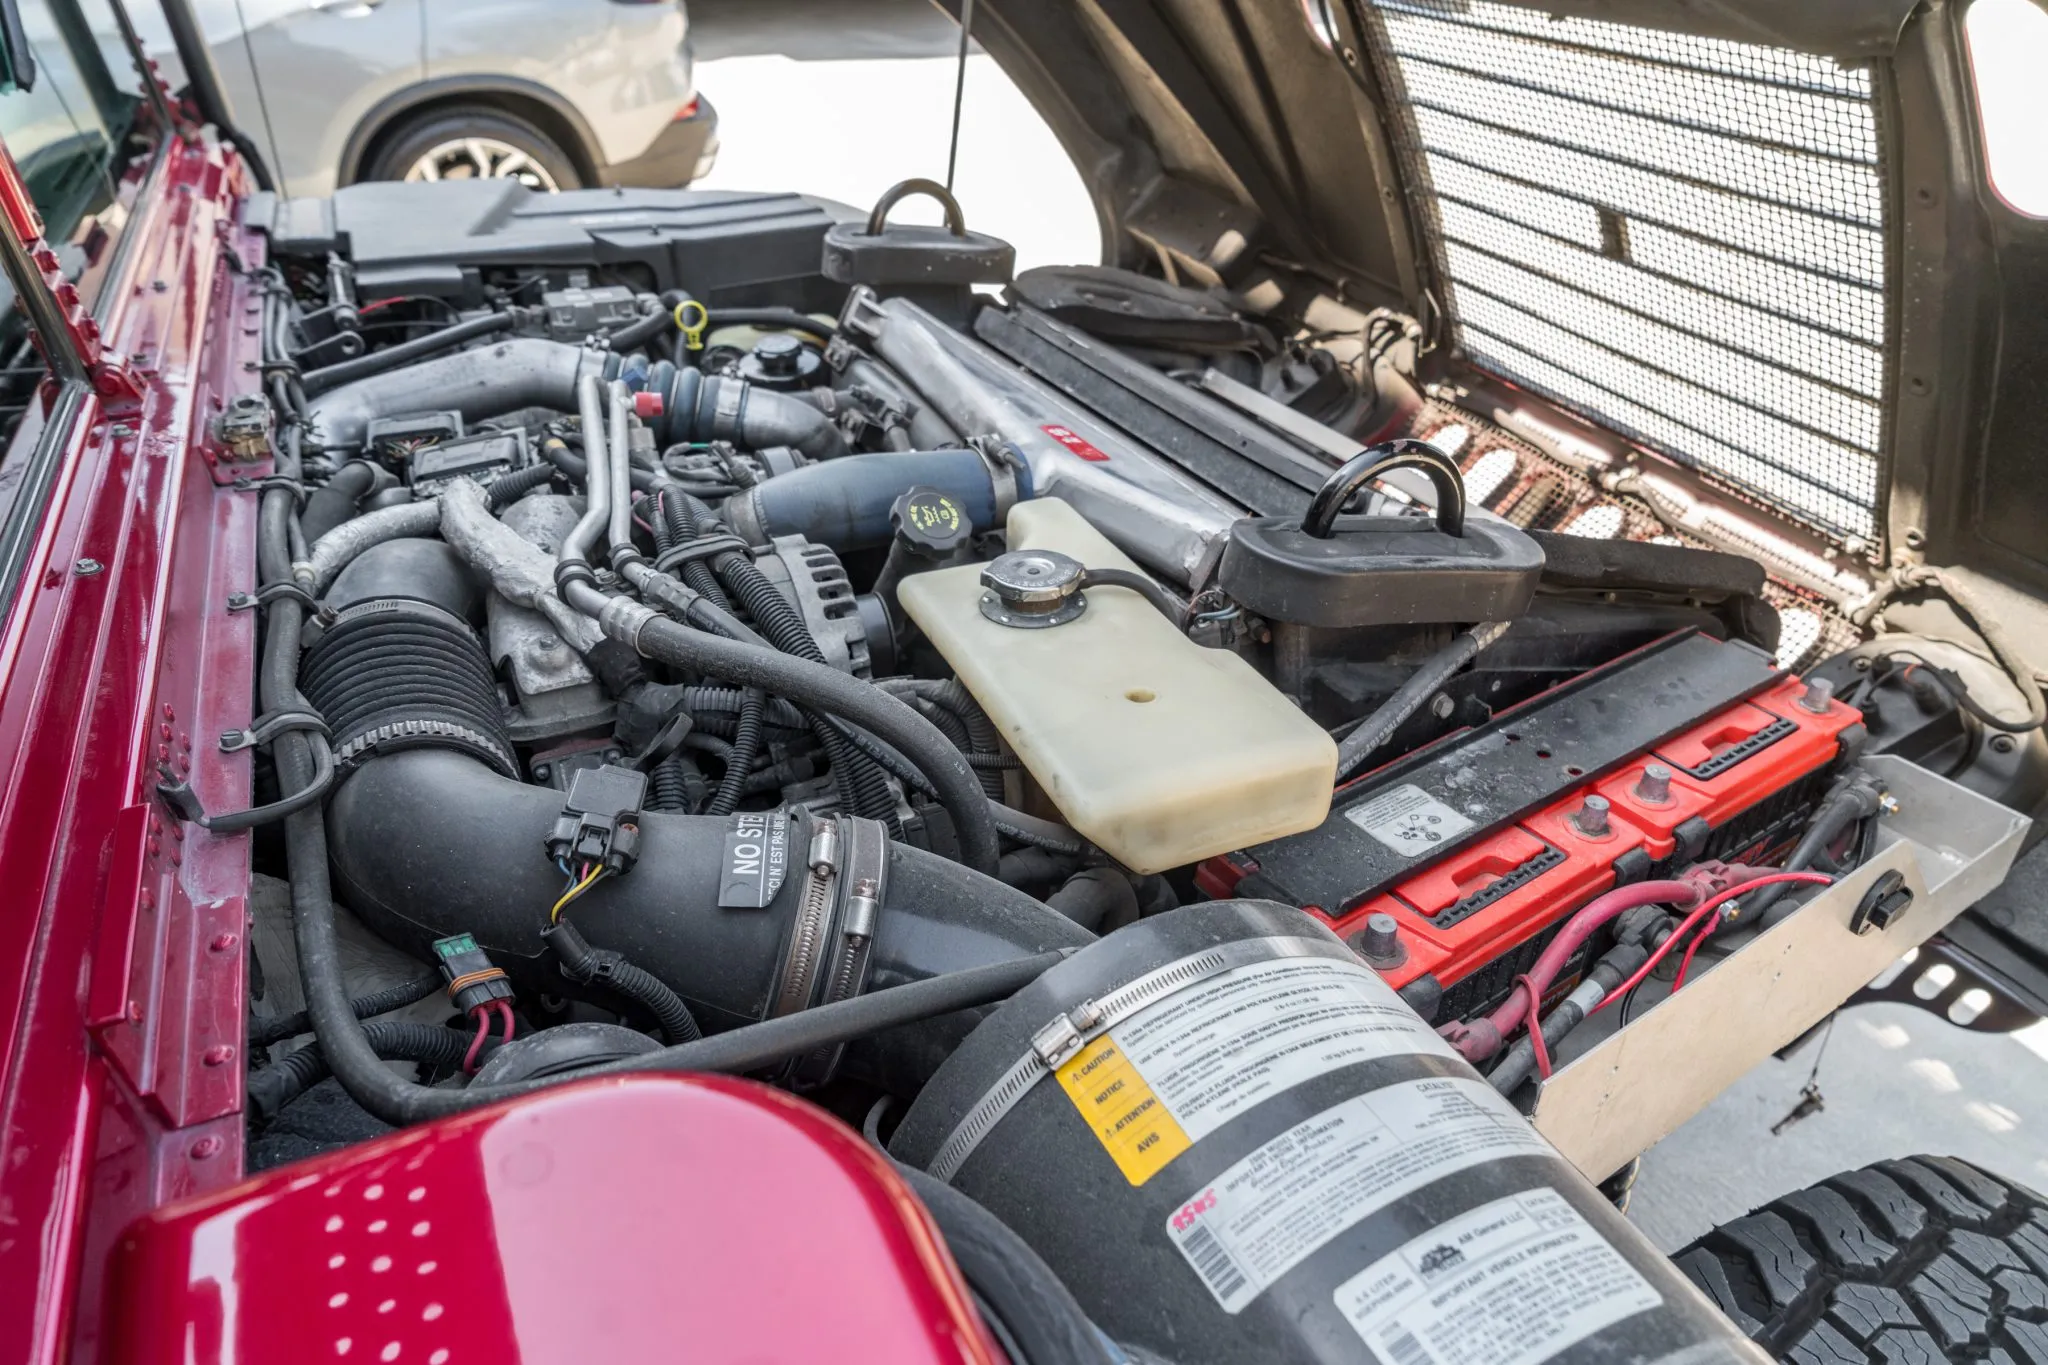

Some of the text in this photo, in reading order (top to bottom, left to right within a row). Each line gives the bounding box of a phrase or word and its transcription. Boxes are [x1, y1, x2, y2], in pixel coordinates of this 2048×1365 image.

[772, 831, 784, 843] PAS
[733, 844, 760, 873] NO
[771, 845, 782, 862] EST
[1143, 1003, 1183, 1028] REFRIGERANT
[1186, 994, 1205, 1005] UNDER
[1206, 987, 1221, 995] HIGH
[1222, 977, 1250, 988] PRESSURE
[1140, 1053, 1151, 1064] USE
[1154, 1043, 1169, 1056] ONLY
[1191, 1011, 1232, 1033] REFRIGERANT
[1233, 1005, 1246, 1013] AND
[1241, 1030, 1257, 1040] SOUS
[1259, 1022, 1276, 1032] HAUTE
[1279, 1013, 1305, 1025] PRESSION
[1081, 1048, 1115, 1075] CAUTION
[1205, 1086, 1213, 1095] LE
[1215, 1074, 1236, 1088] FLUIDE
[1300, 1034, 1331, 1048] SEULEMENT
[1095, 1079, 1125, 1104] NOTICE
[1114, 1097, 1155, 1131] ATTENTION
[1137, 1132, 1160, 1154] AVIS
[1267, 1135, 1291, 1152] MODEL
[1293, 1124, 1310, 1137] YEAR
[1226, 1158, 1267, 1193] IMPORTANT
[1269, 1143, 1294, 1161] ENGINE
[1296, 1117, 1343, 1145] INFORMATION
[1279, 1150, 1302, 1168] Engine
[1474, 1217, 1506, 1237] General
[1507, 1211, 1524, 1222] LLC
[1431, 1270, 1486, 1307] IMPORTANT
[1488, 1251, 1525, 1275] VEHICLE
